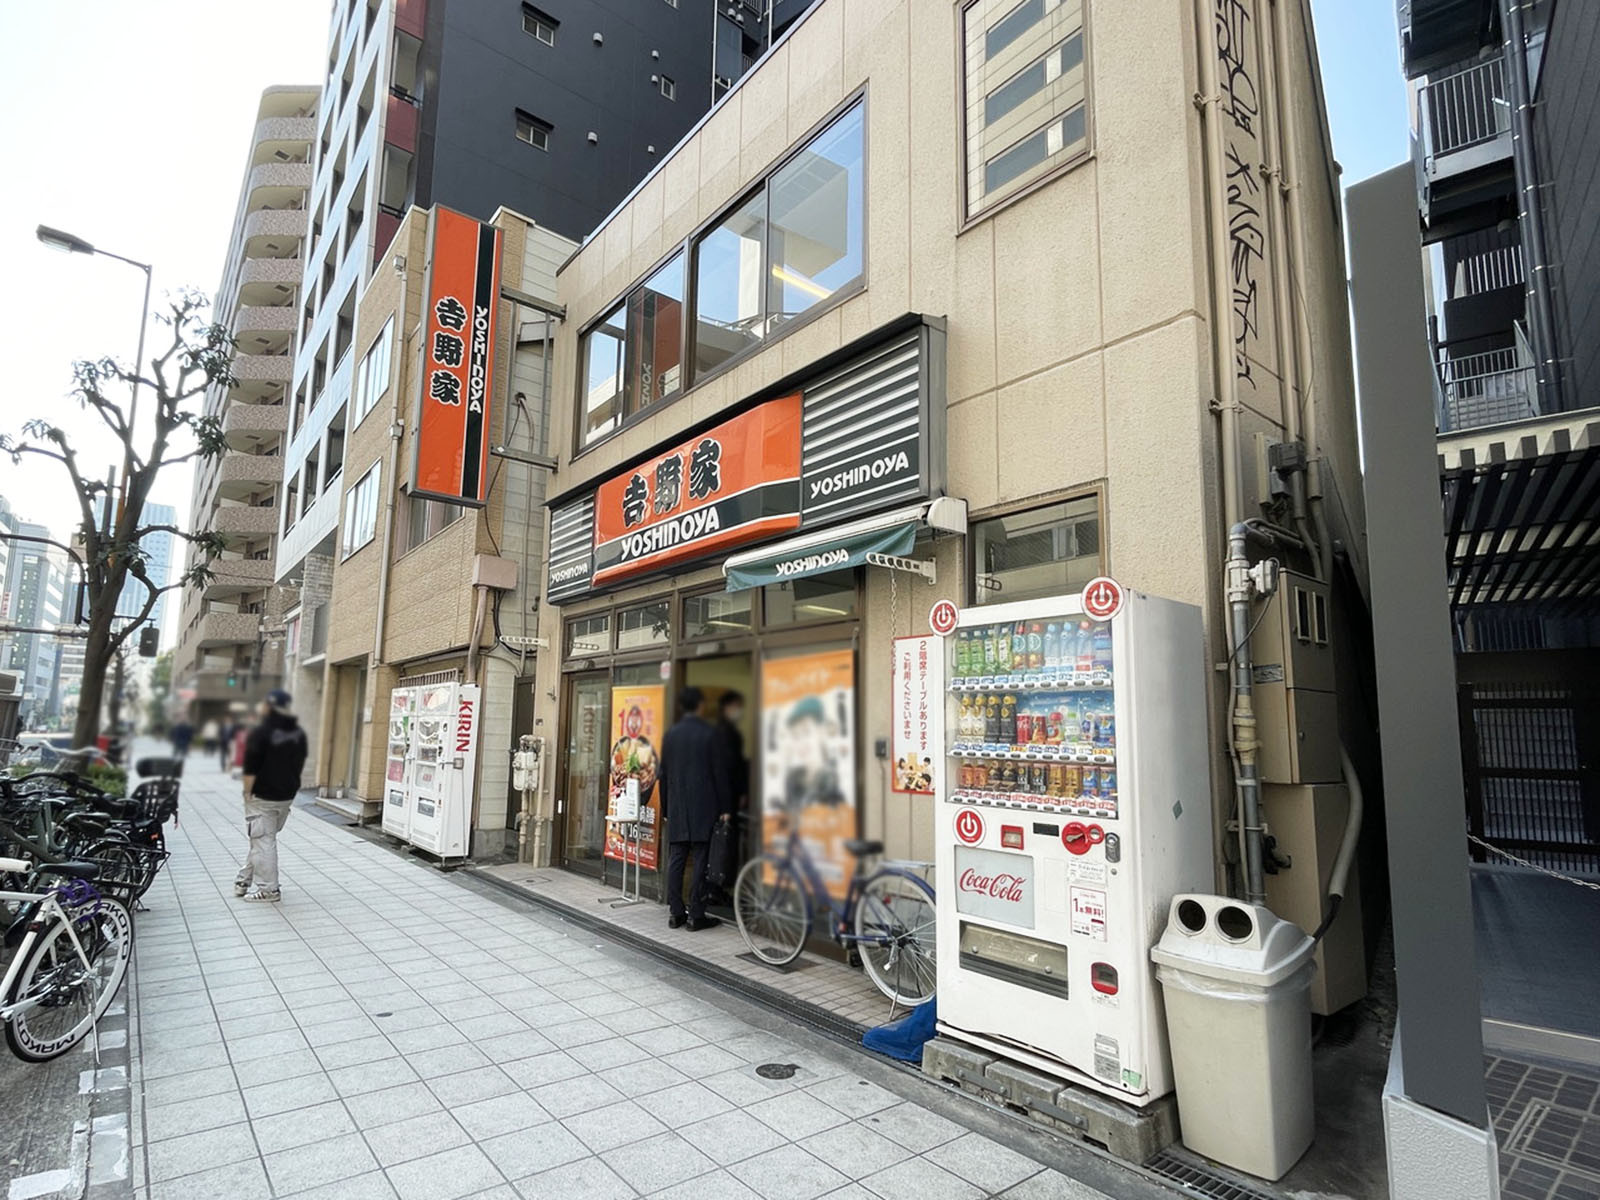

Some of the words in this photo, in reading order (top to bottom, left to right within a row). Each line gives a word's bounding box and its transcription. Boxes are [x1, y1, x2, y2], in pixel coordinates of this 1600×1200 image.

[469, 304, 489, 414] YOSHINOYA
[621, 437, 723, 529] 吉野家
[810, 450, 910, 500] YOSHINOYA
[620, 505, 721, 561] YOSHINOYA
[551, 562, 588, 585] YOSHINOYA
[775, 548, 849, 577] YOSHINOYA
[455, 700, 474, 752] KIRIN
[959, 868, 1026, 902] Coca-Cola
